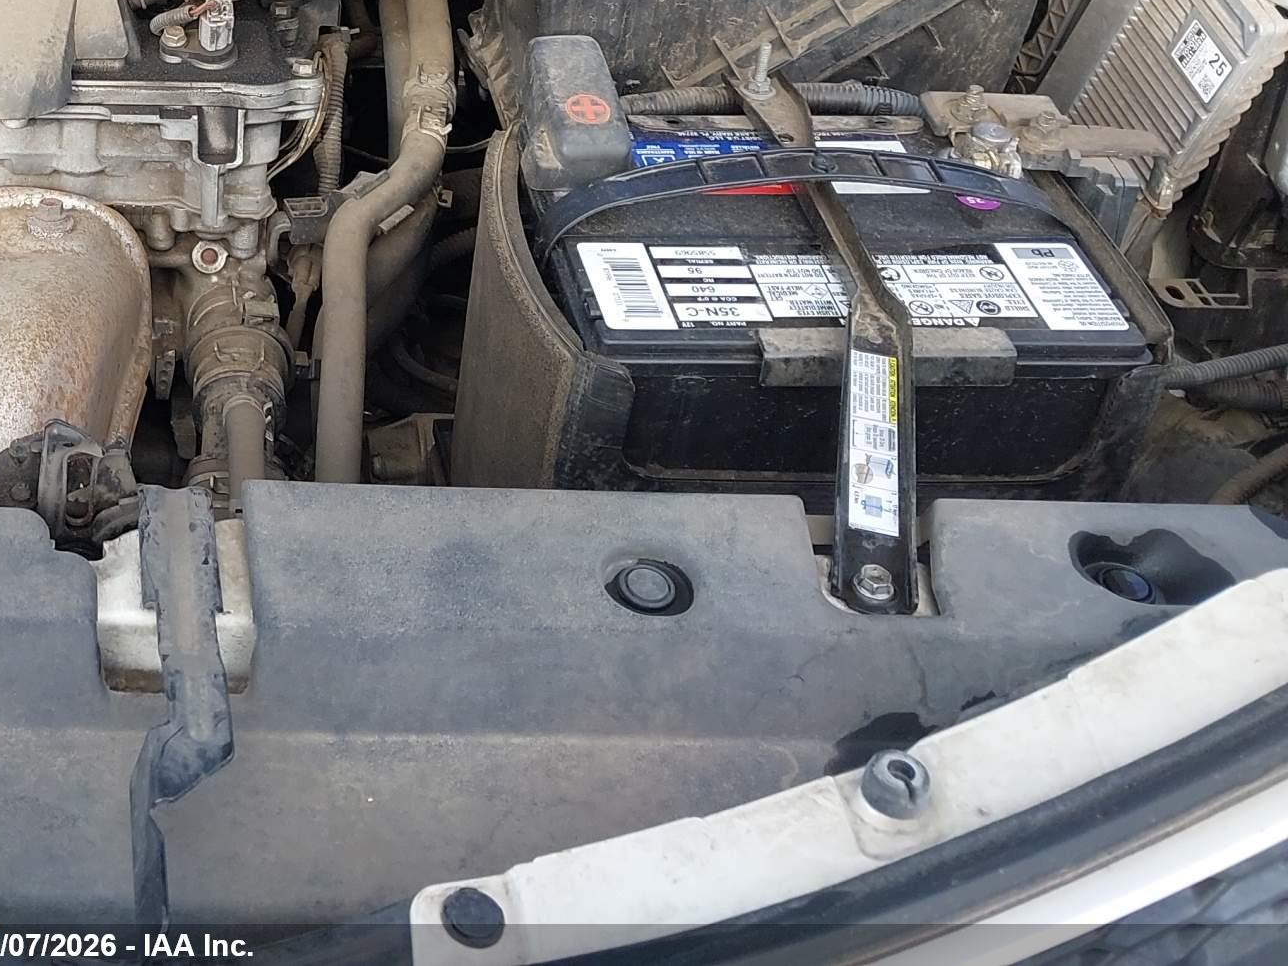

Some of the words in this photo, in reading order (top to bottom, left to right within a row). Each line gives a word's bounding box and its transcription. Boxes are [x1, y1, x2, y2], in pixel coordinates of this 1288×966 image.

[1209, 52, 1228, 77] 25
[1031, 248, 1055, 258] Pb
[687, 266, 703, 274] 95
[691, 285, 716, 293] 640
[685, 307, 741, 317] 35N-C
[909, 317, 966, 326] DANGE
